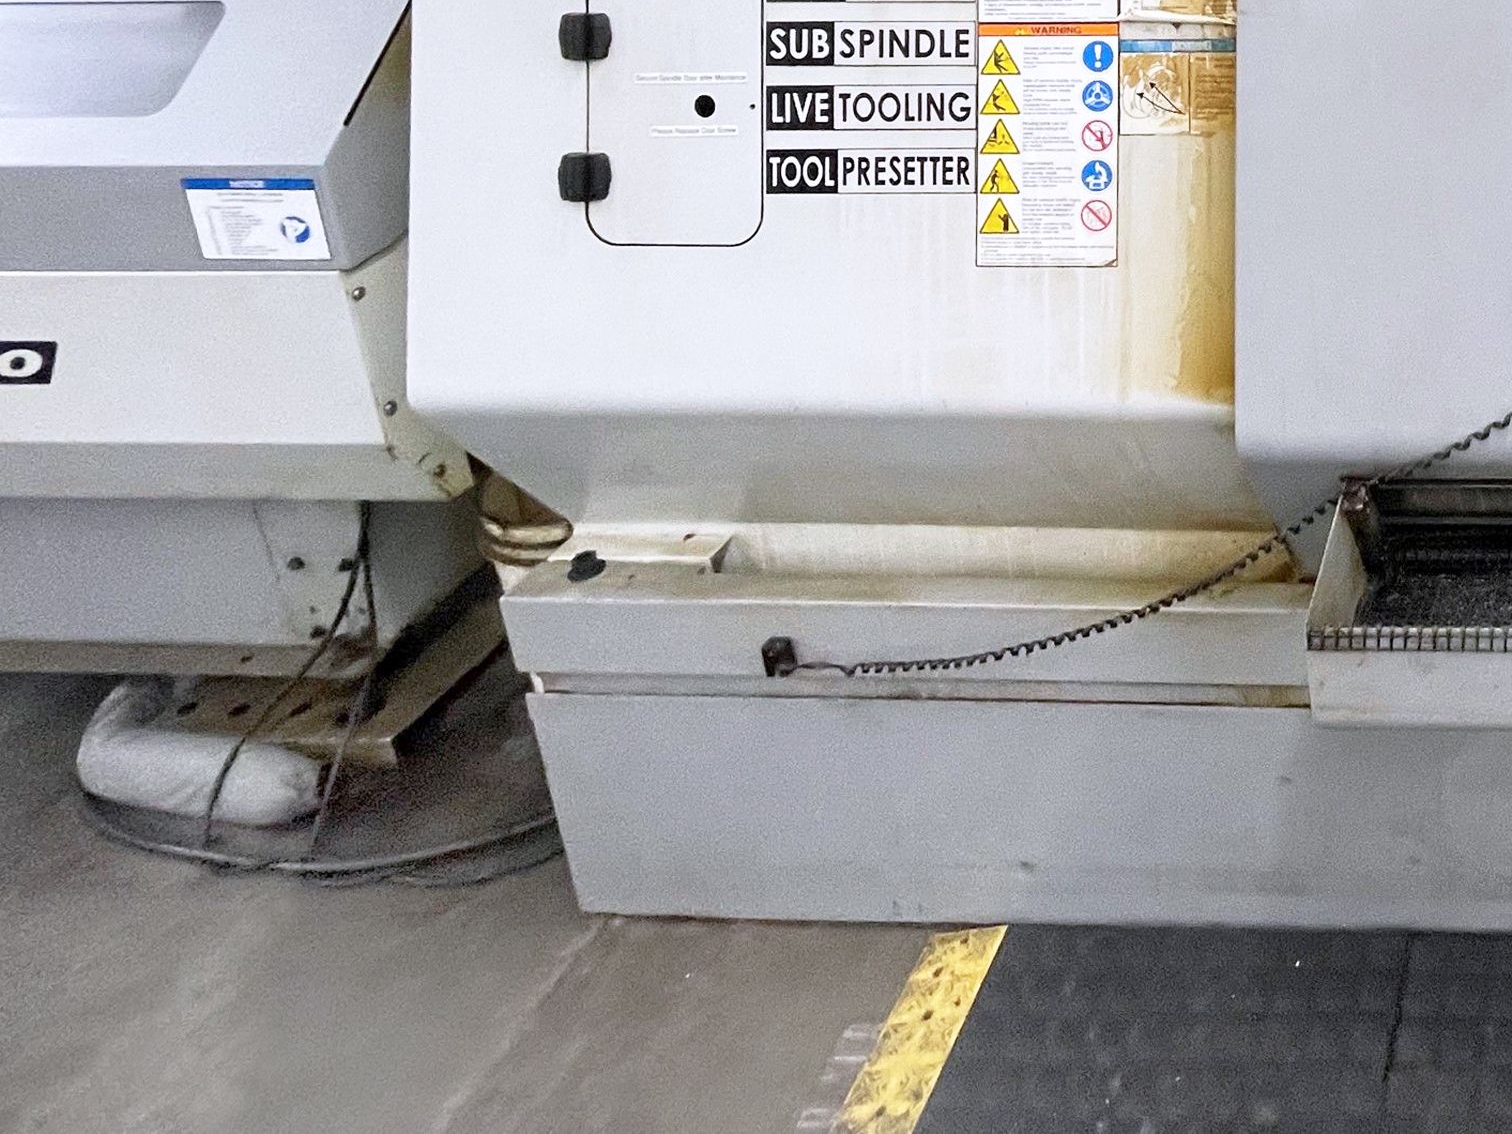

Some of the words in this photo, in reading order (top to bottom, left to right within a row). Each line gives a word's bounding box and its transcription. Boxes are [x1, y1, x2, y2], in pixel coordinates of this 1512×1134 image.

[769, 27, 830, 60] SUB
[839, 28, 970, 59] SPINDLE
[1031, 26, 1083, 35] WARNING
[771, 92, 829, 123] LIVE
[839, 92, 971, 122] TOOLING
[769, 155, 835, 187] TOOL
[842, 155, 970, 186] PRESETTER
